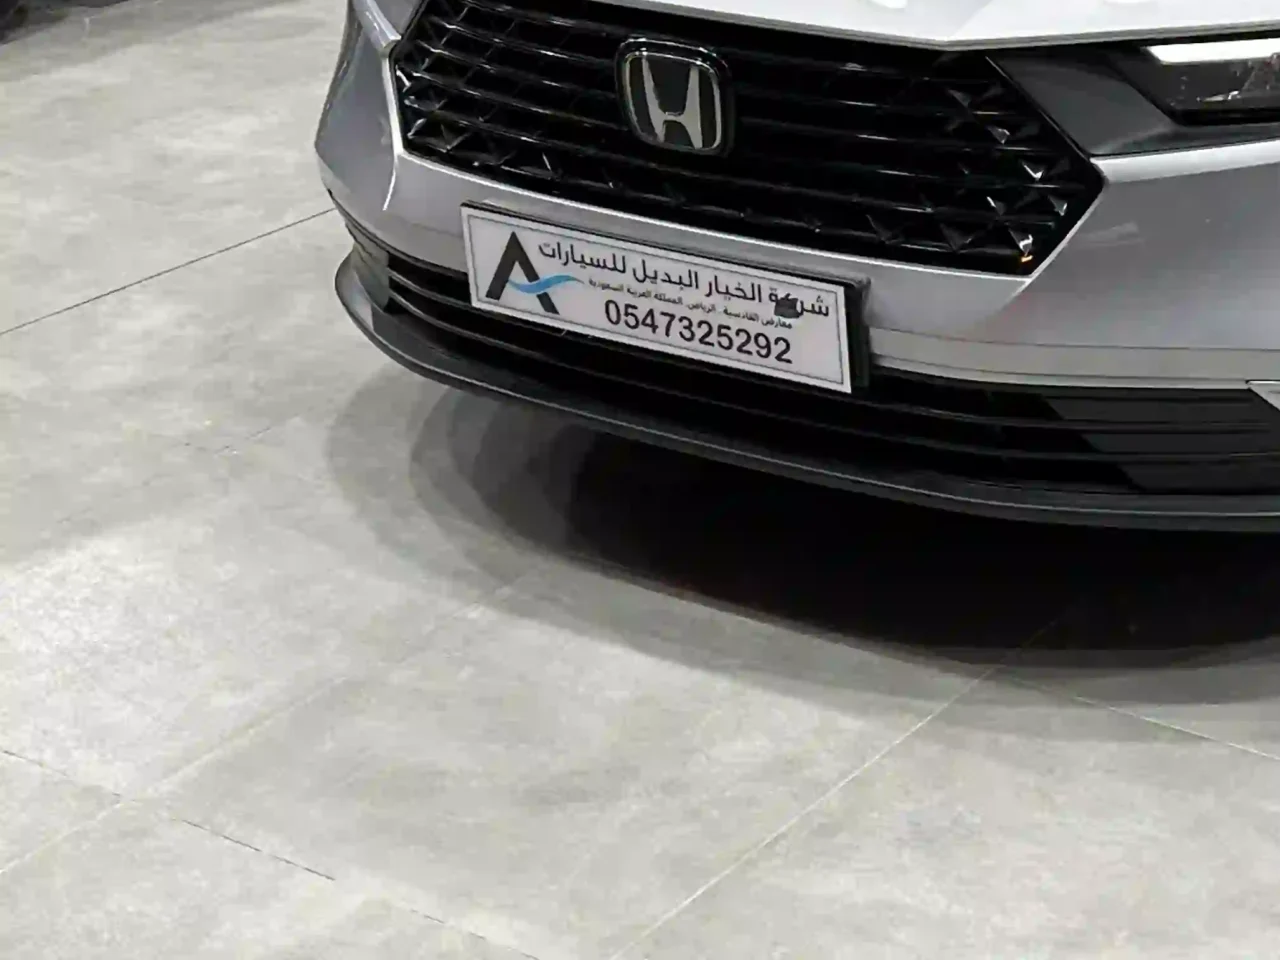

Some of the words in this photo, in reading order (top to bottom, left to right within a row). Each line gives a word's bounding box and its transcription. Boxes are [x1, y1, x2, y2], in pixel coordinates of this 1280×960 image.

[537, 241, 626, 274] للسيارات
[632, 259, 699, 291] البديل
[704, 276, 762, 303] الخيار
[604, 299, 793, 365] 0547325292
